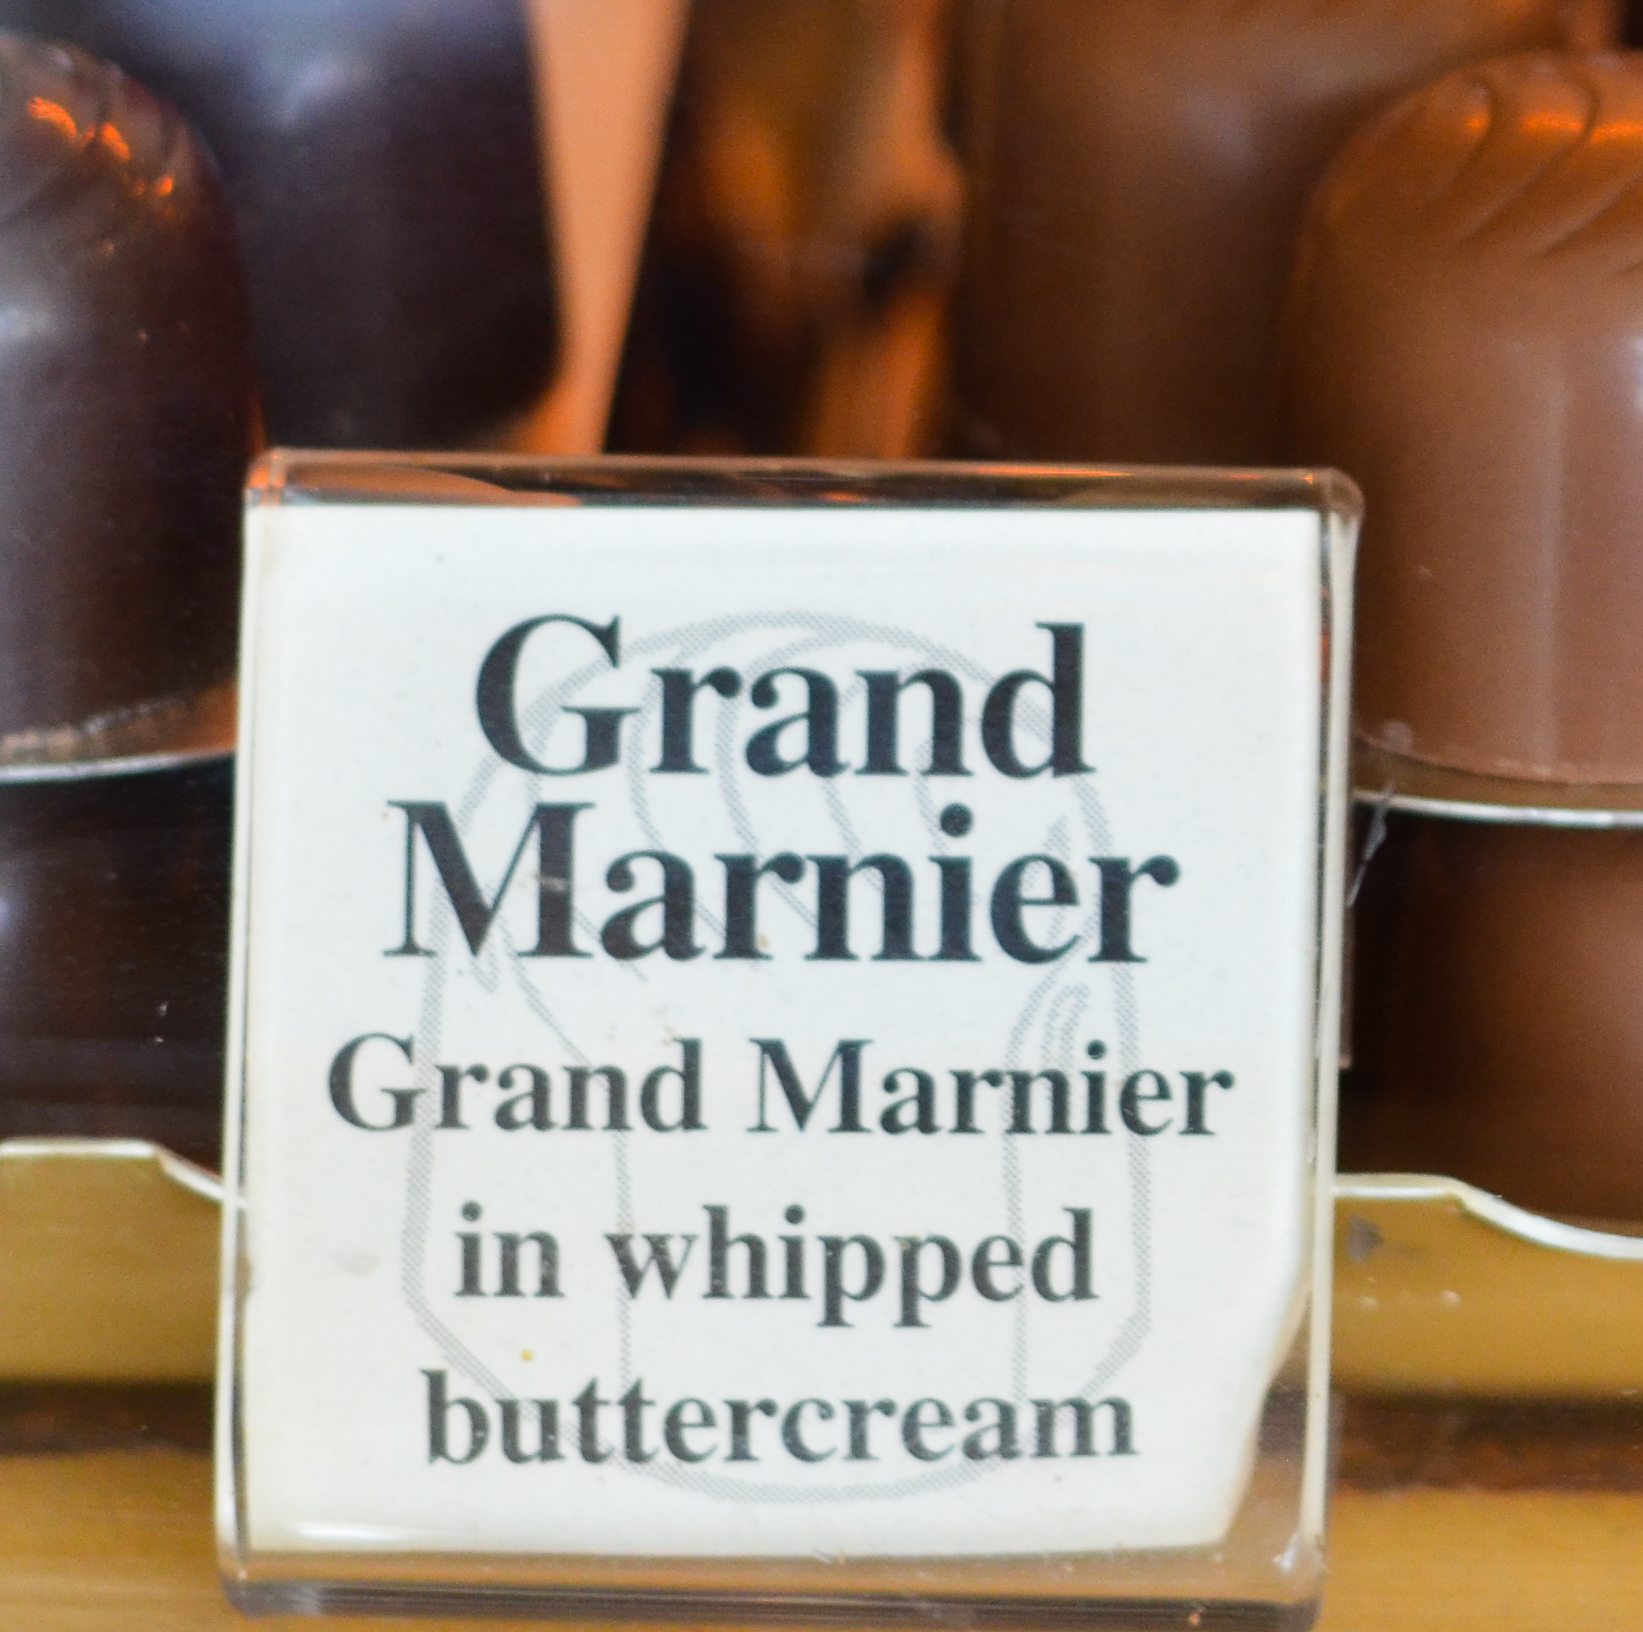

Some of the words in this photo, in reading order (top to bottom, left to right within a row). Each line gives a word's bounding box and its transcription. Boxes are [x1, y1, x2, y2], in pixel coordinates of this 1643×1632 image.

[474, 614, 1096, 779] Grand
[381, 799, 1181, 965] Marnier
[326, 1033, 708, 1133] Grand
[747, 1037, 1236, 1137] Marnier
[453, 1201, 565, 1300] in
[604, 1203, 1100, 1328] whipped
[419, 1369, 1138, 1465] buttercream
